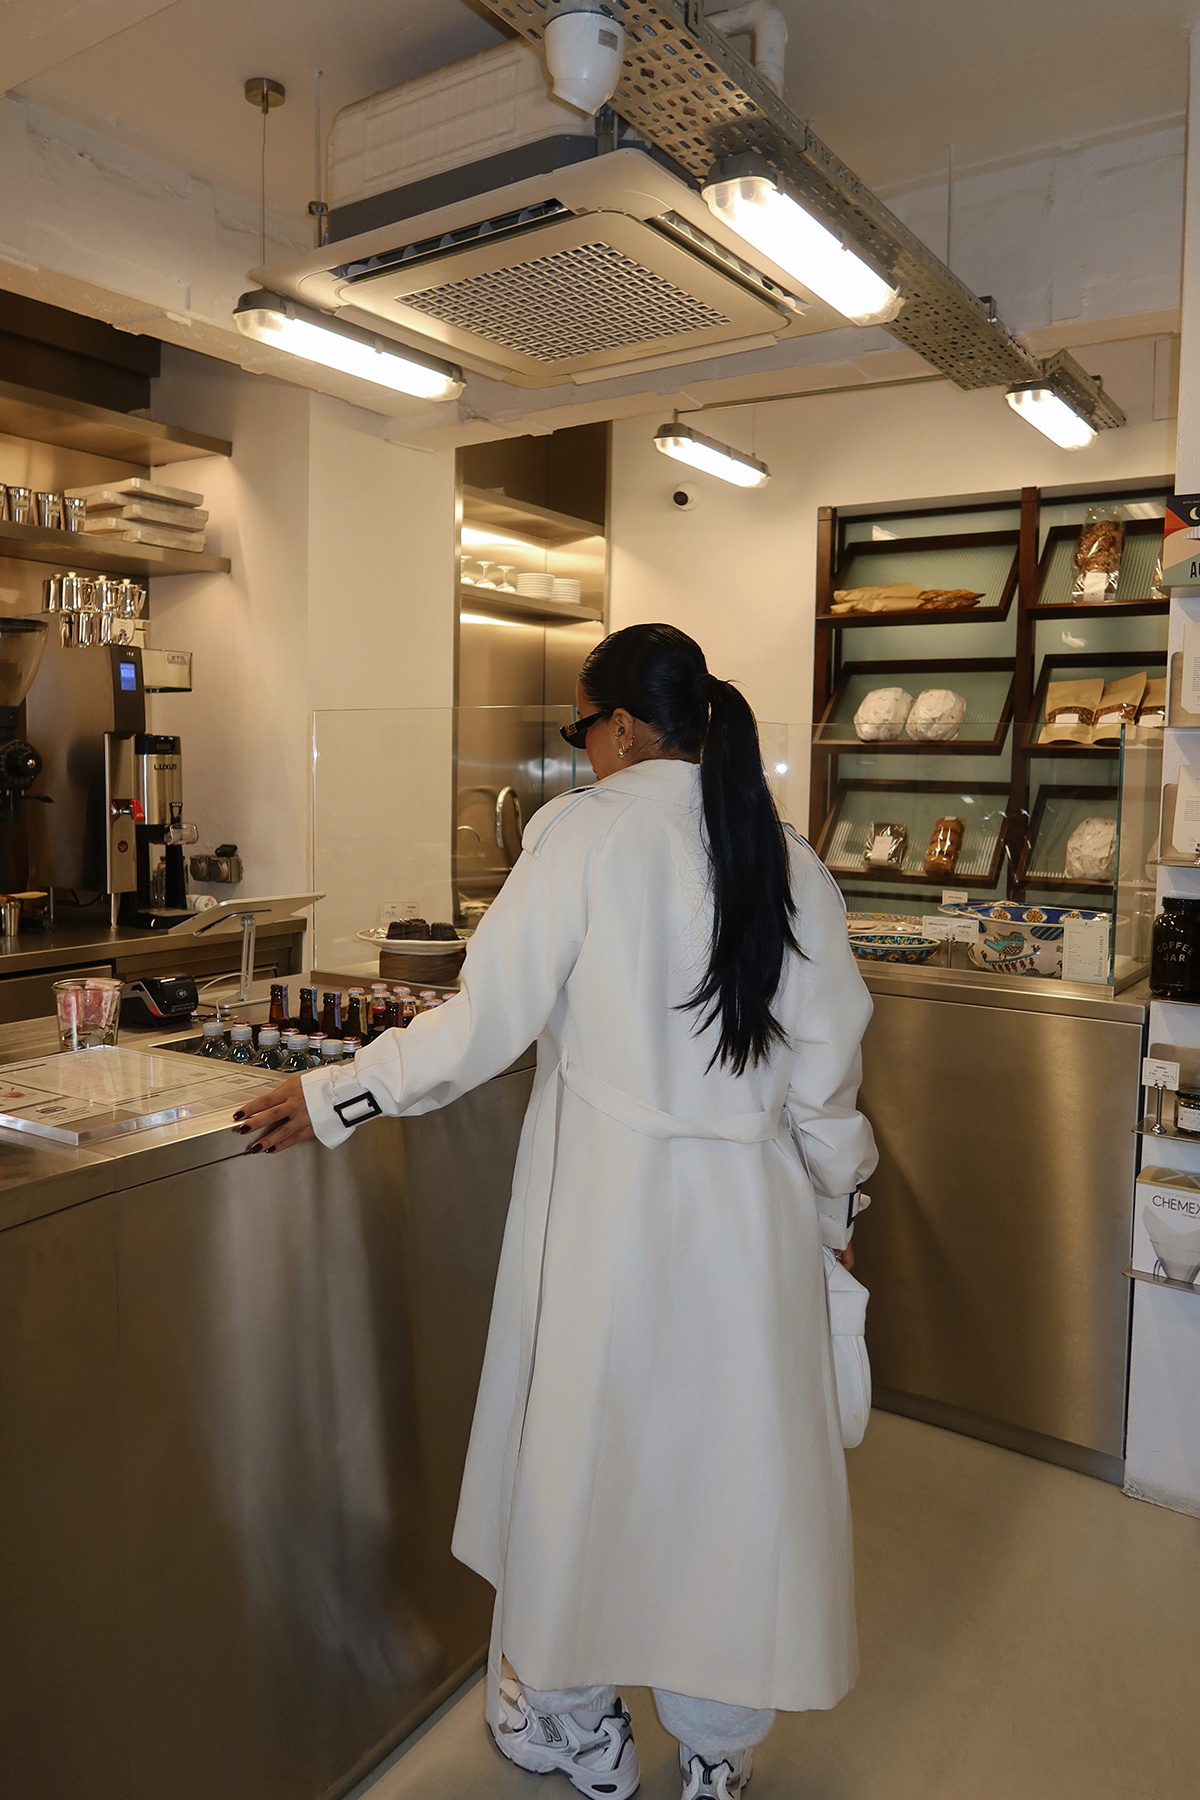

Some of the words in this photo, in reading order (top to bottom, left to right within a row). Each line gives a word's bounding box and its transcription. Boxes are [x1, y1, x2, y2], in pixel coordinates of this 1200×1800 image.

[153, 763, 177, 771] LUXUS
[1157, 941, 1194, 956] COFFEE
[1163, 953, 1186, 962] JAR
